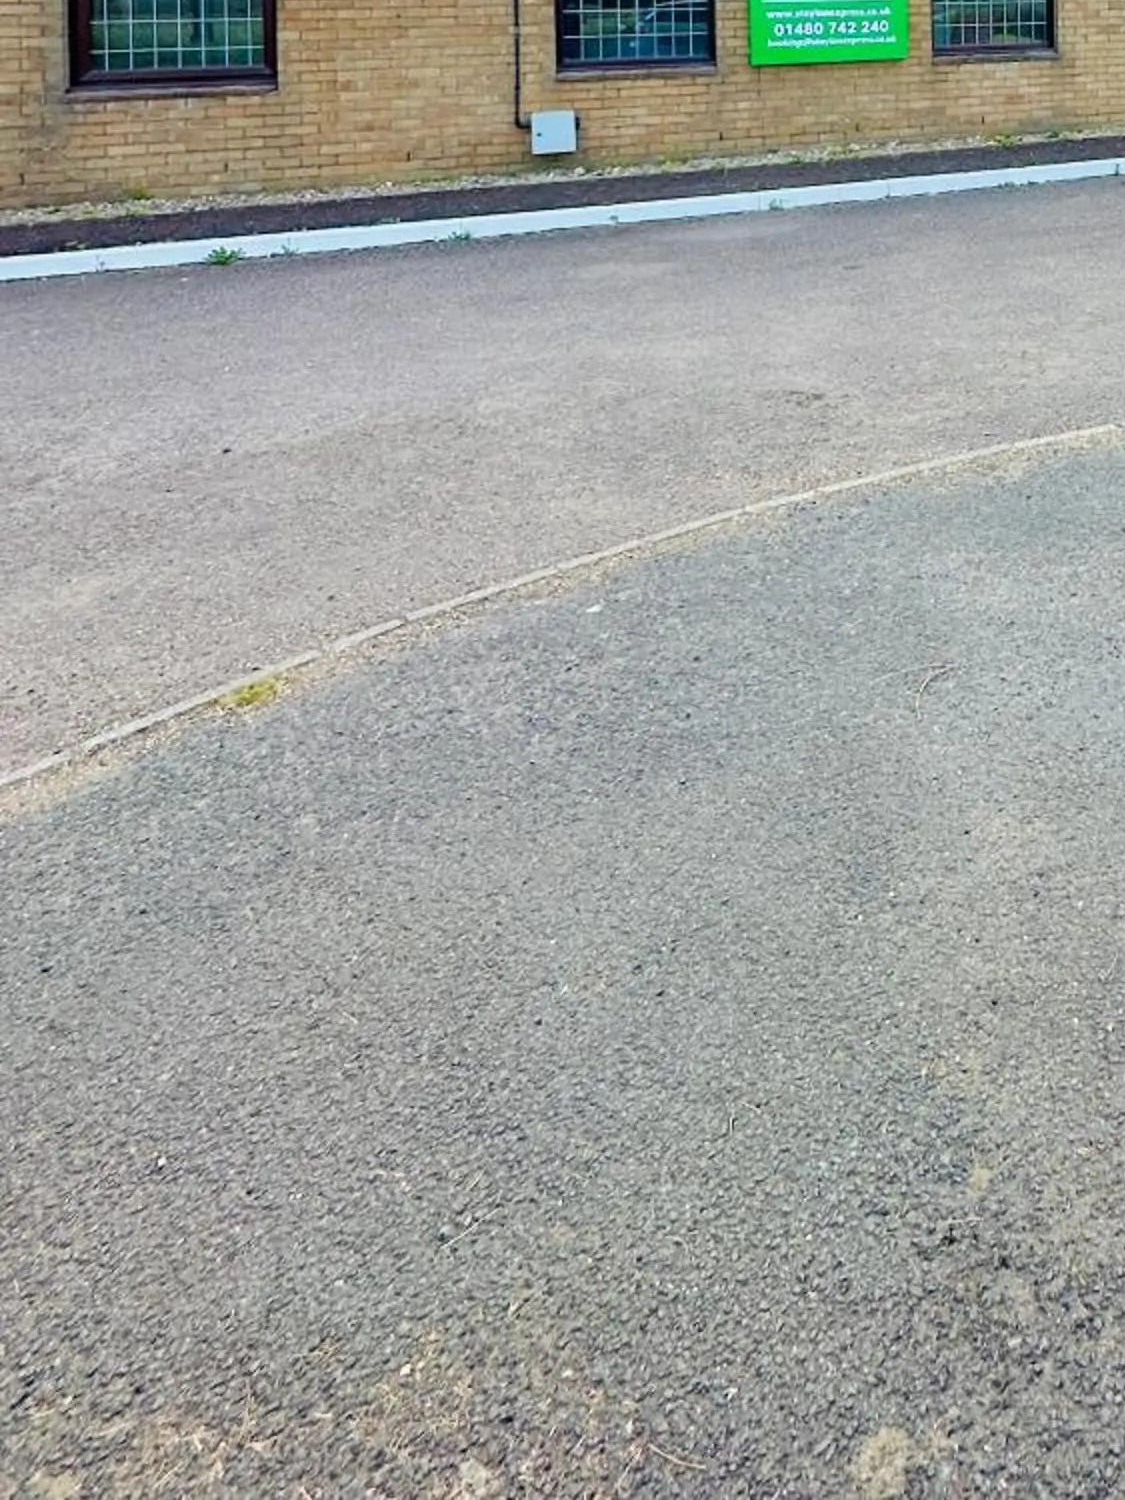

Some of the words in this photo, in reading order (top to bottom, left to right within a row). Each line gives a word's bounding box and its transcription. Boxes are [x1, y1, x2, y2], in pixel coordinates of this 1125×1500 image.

[774, 22, 823, 36] 01480
[829, 21, 857, 34] 742
[861, 19, 889, 33] 240
